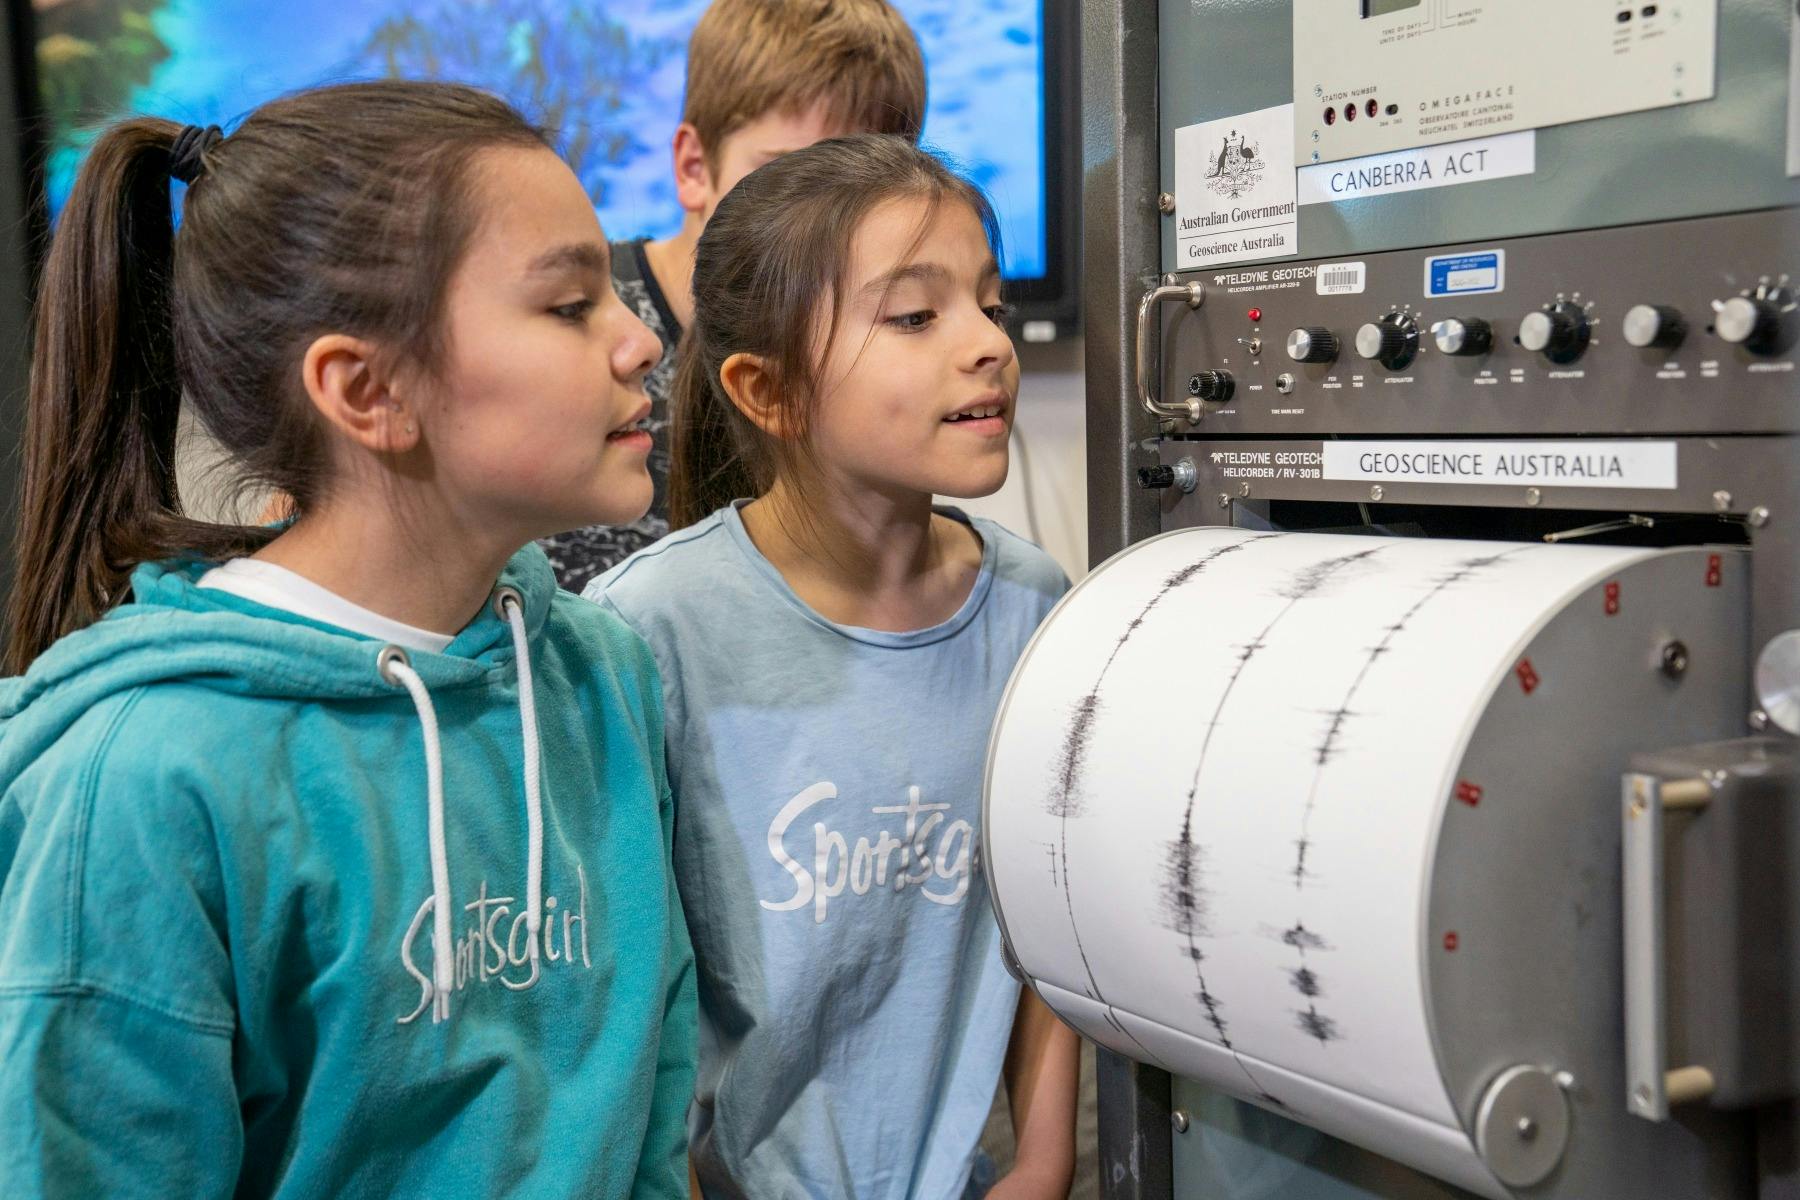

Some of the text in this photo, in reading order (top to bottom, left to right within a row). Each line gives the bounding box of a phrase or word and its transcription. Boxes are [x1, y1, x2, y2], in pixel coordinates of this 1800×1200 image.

[1322, 86, 1377, 102] STATION NUMBER
[1419, 103, 1513, 125] OBSERVATOIRE CANTONAL
[1419, 113, 1514, 136] NEUCHATEL SWITZERLAND
[1331, 150, 1488, 192] CANBERRA ACT
[1179, 200, 1295, 230] Australian Government
[1189, 233, 1284, 257] Geoscience Australia
[1226, 271, 1268, 285] TELEDYNE
[1272, 266, 1317, 281] GEOTECH
[1228, 285, 1255, 293] HELICORDER
[1223, 453, 1323, 464] TELEDYNE GEOTECH
[1360, 454, 1623, 477] GEOSCIENCE AUSTRALIA
[1224, 468, 1274, 478] HELICORDER
[1283, 468, 1320, 478] RV-301B
